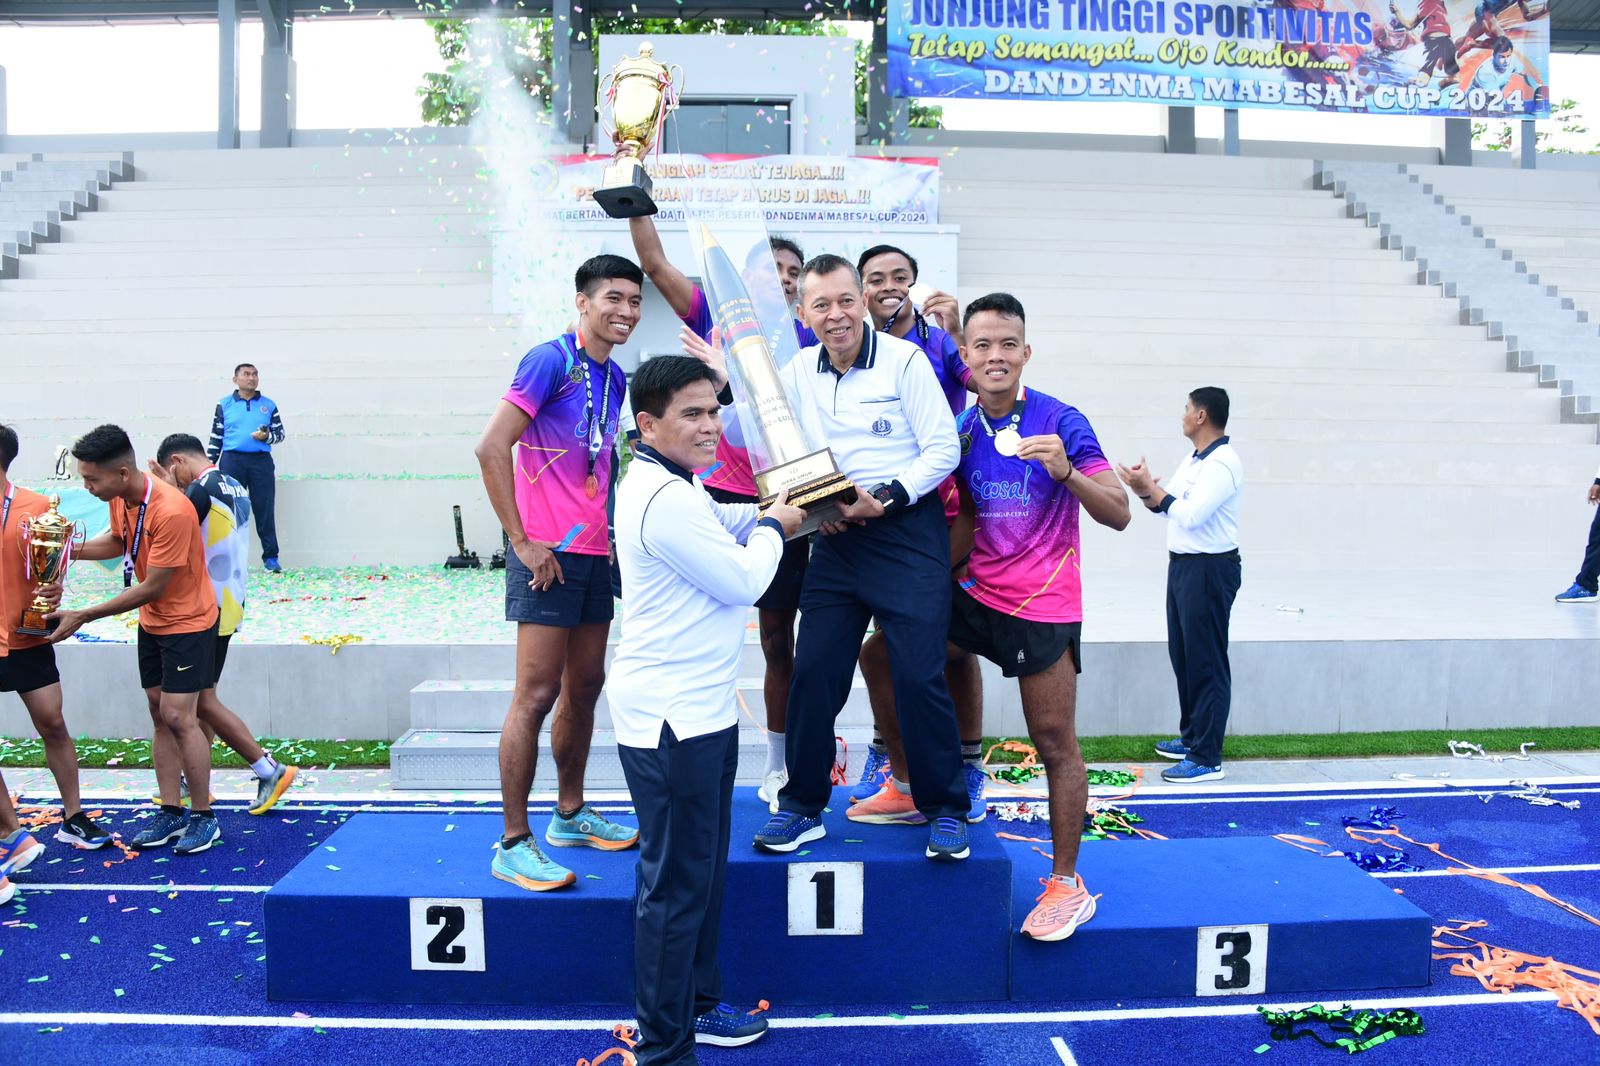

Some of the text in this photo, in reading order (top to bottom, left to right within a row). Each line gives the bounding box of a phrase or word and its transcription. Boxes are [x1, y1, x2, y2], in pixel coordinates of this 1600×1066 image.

[910, 0, 1373, 46] JUNJUNG TINGGI SPORTIVITAS
[907, 32, 985, 64] Tetap
[1158, 38, 1208, 68] Ojo
[984, 69, 1525, 112] DANDENMA MABESAL CUP 2024
[697, 187, 739, 202] TETAP
[794, 188, 809, 204] DI
[765, 211, 823, 221] DANDENMA
[826, 211, 875, 221] MABESAL
[877, 211, 898, 222] CUP
[900, 212, 925, 222] 2024
[809, 870, 836, 929] 1
[426, 905, 466, 964] 2
[1214, 931, 1252, 990] 3
